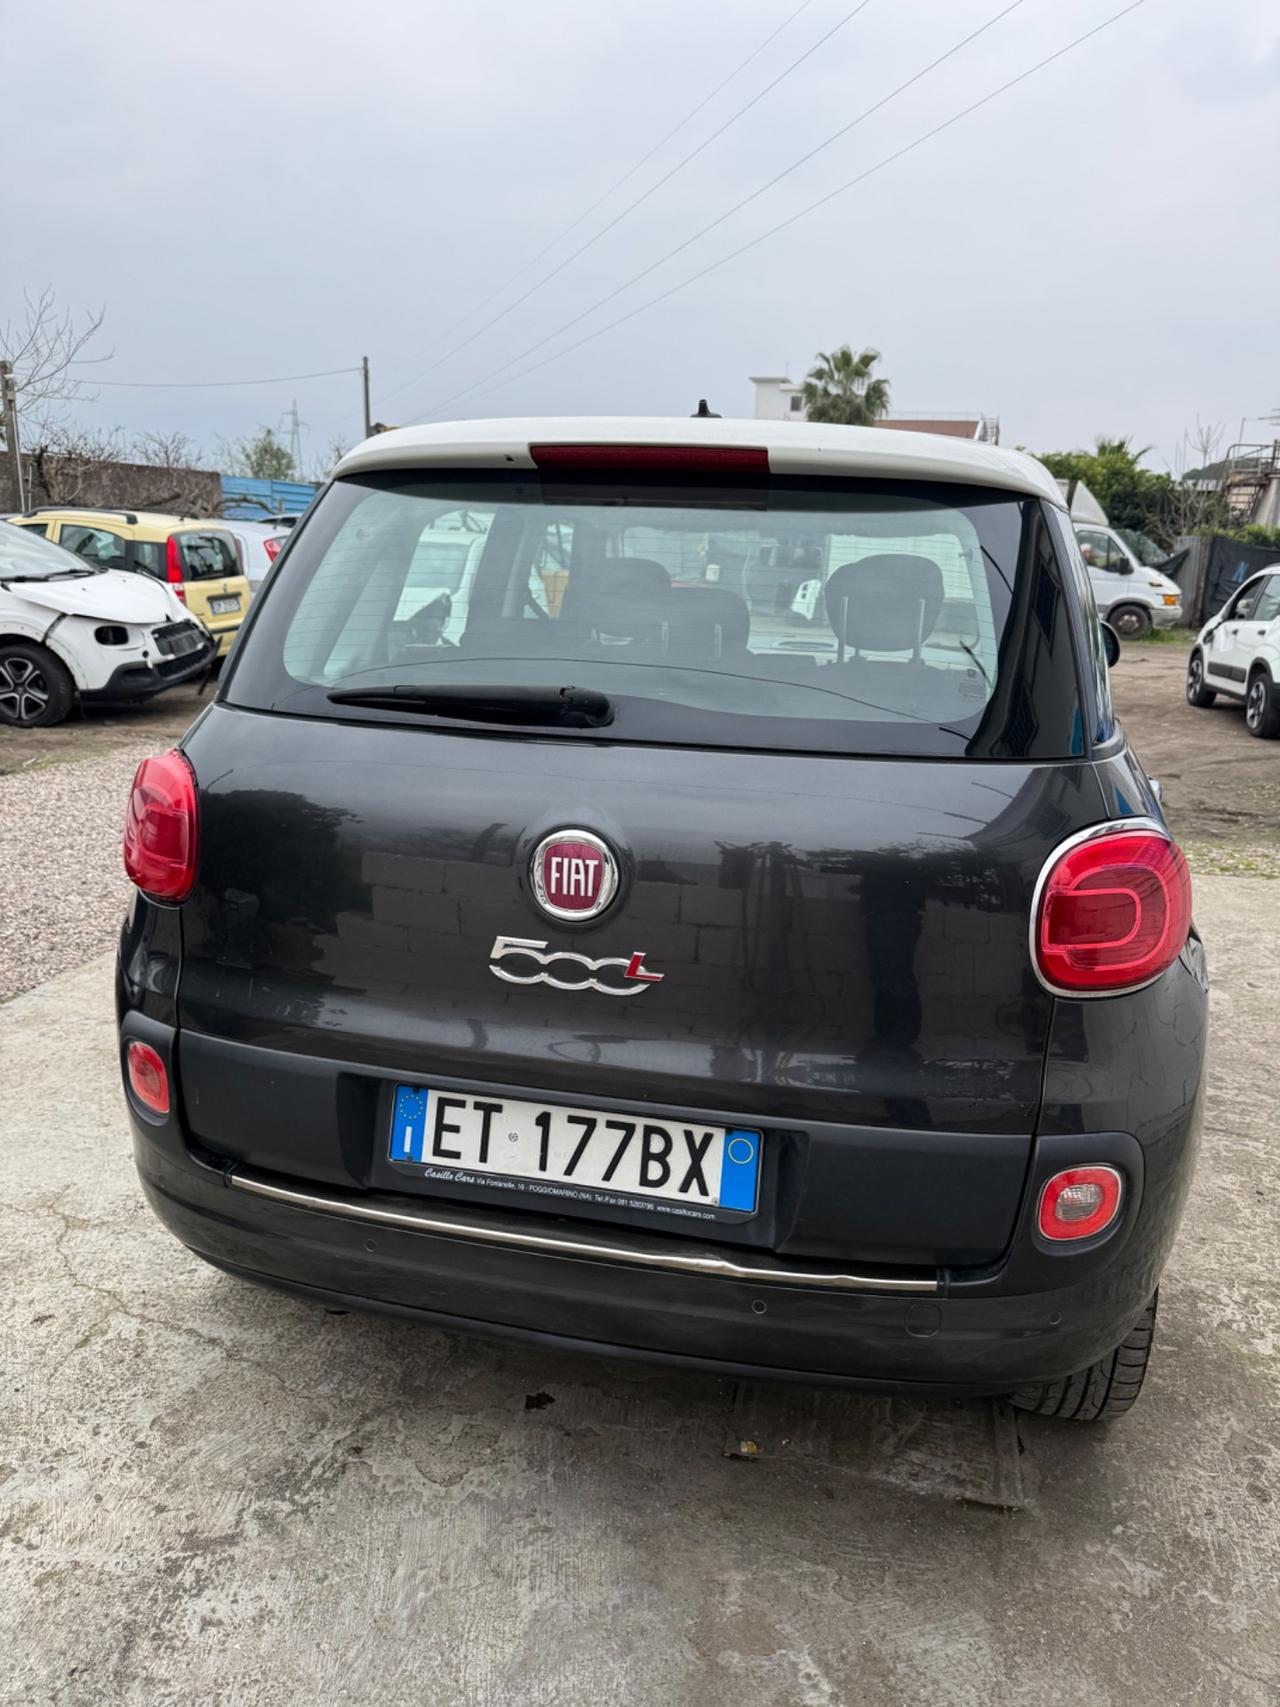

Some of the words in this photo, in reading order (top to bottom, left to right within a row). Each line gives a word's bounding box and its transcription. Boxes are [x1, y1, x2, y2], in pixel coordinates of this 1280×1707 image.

[551, 857, 599, 896] FIAT
[403, 1126, 412, 1153] I
[432, 1097, 503, 1163] ET
[535, 1111, 714, 1197] 177BX
[424, 1167, 454, 1181] Casillo
[455, 1172, 475, 1184] Cars
